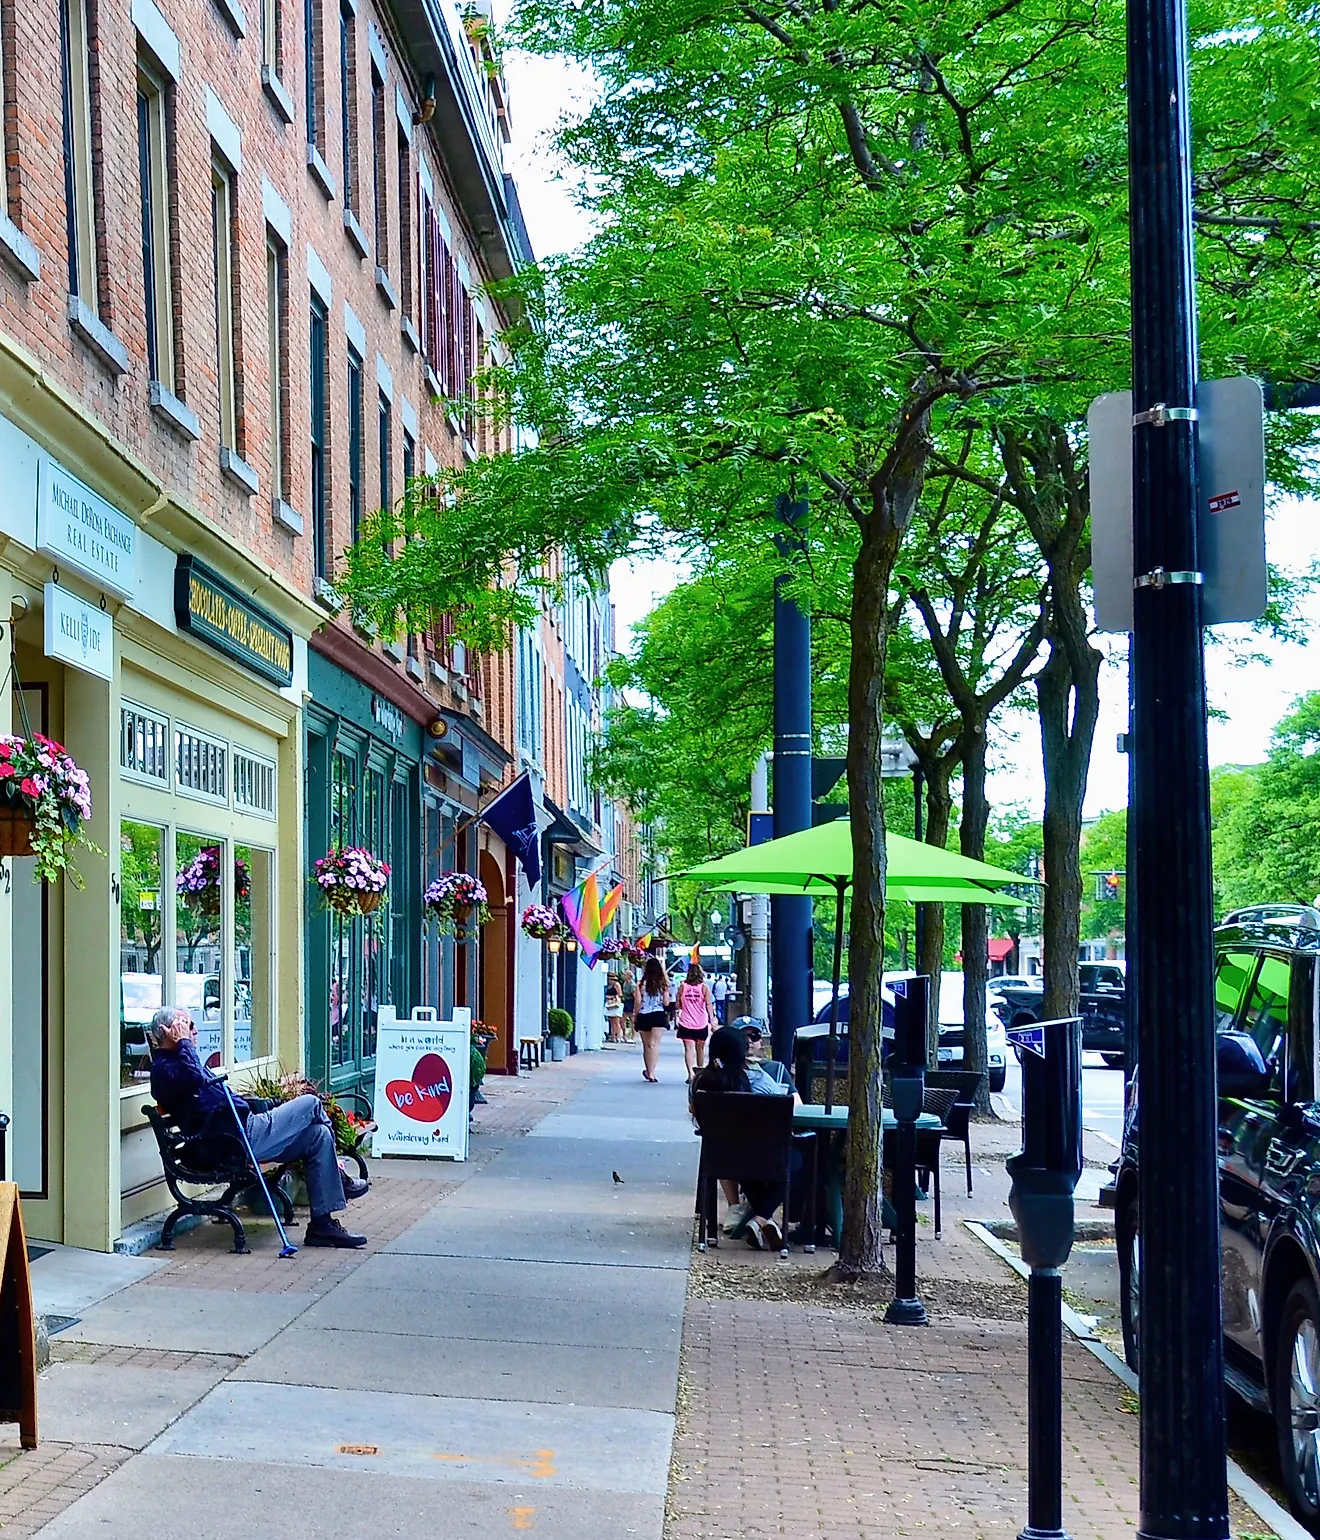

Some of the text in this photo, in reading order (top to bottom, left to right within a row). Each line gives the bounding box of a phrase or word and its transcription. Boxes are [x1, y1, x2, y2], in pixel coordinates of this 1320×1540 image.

[51, 481, 79, 520] MICHAEL
[104, 518, 132, 555] EXCHANGE
[67, 524, 119, 573] REAL ESTATE
[60, 611, 101, 652] KELLI IDE
[112, 872, 120, 904] 50
[418, 1035, 444, 1044] world
[393, 1076, 450, 1109] be kind
[387, 1132, 429, 1145] Wandering
